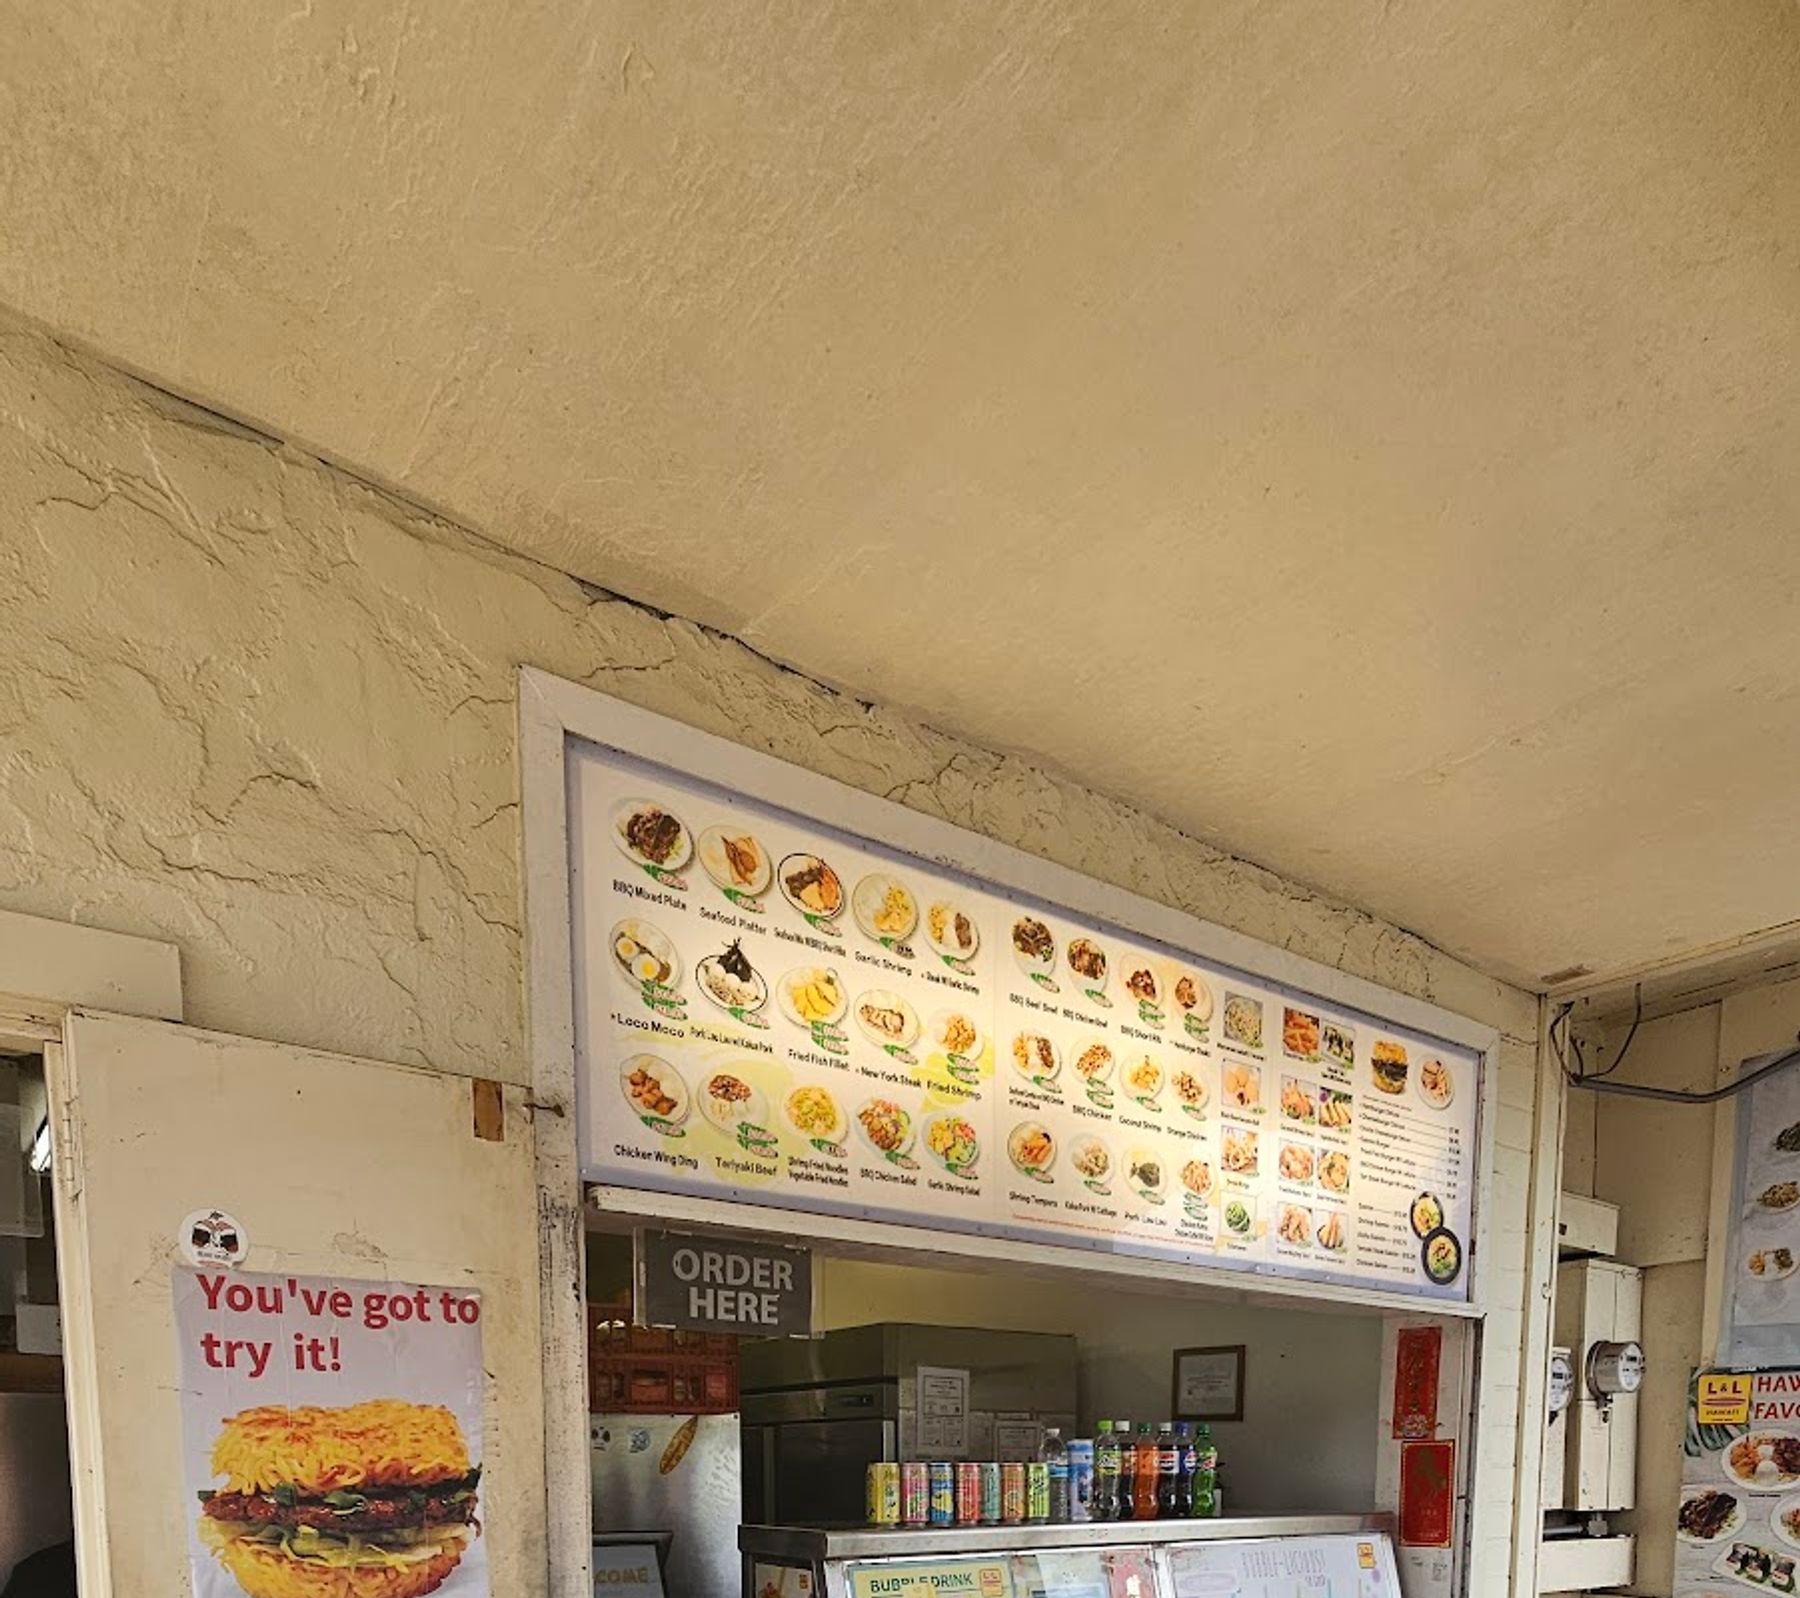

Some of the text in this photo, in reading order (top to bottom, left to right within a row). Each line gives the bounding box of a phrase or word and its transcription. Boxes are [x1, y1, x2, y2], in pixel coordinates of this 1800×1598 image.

[617, 1012, 685, 1038] Loco Moco
[927, 1080, 982, 1101] Fried Shrimp
[614, 1144, 653, 1161] Chicken
[653, 1150, 677, 1166] Wing
[715, 1157, 778, 1176] Teriyaki Beef
[672, 1249, 793, 1291] ORDER
[197, 1273, 481, 1330] You've got to
[689, 1286, 780, 1325] HERE
[200, 1332, 342, 1377] try it!
[930, 1572, 973, 1588] DRINK
